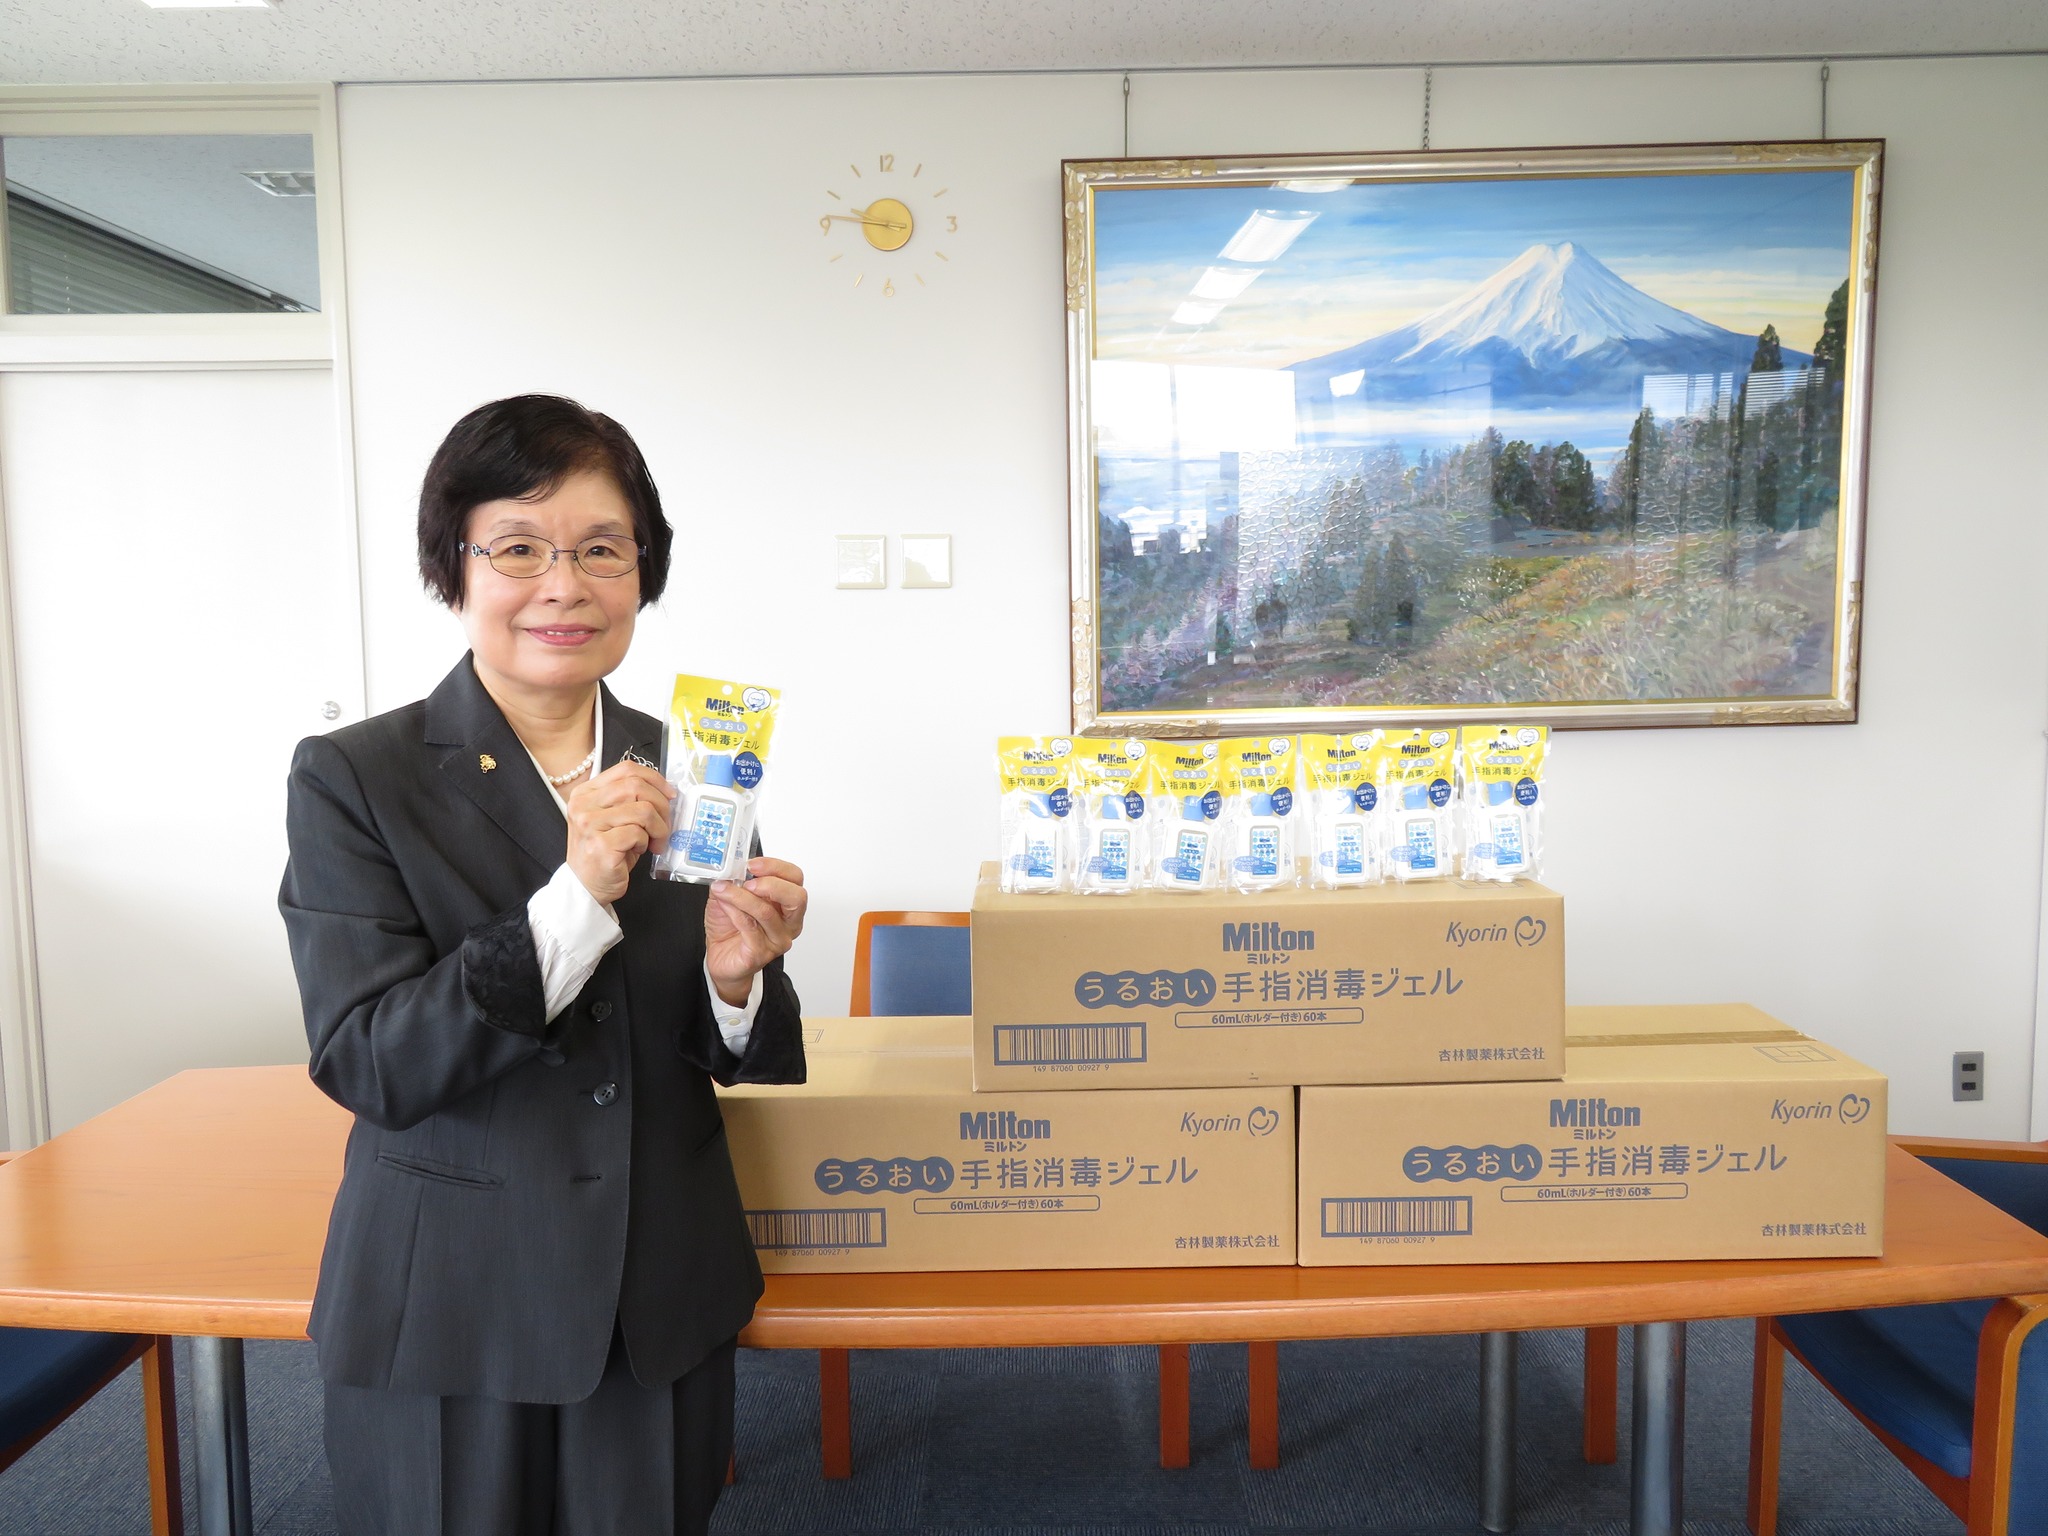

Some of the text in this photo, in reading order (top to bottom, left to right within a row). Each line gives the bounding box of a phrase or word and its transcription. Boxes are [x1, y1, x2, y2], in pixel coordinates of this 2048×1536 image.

[880, 154, 894, 172] 12
[819, 214, 832, 236] 9
[946, 215, 958, 233] 3
[882, 277, 895, 297] 6
[1242, 752, 1272, 762] Milton
[1401, 745, 1431, 754] Milton
[1175, 756, 1204, 767] Milton
[1222, 922, 1315, 952] Milton
[1445, 921, 1508, 947] Kyorin
[1247, 953, 1290, 964] ミルトン
[1084, 967, 1464, 1003] うるおい 手指消毒ジェル
[1438, 1047, 1545, 1061] 杏林製薬株式会社
[1104, 1063, 1110, 1071] 9
[1550, 1098, 1641, 1128] Milton
[1771, 1099, 1832, 1125] Kyorin
[960, 1111, 1051, 1140] Milton
[1180, 1111, 1241, 1137] Kyorin
[1573, 1129, 1616, 1140] ミルトン
[984, 1141, 1027, 1152] ミルトン
[1411, 1144, 1788, 1178] うるおい 手指消毒ジェル
[824, 1156, 1198, 1190] うるおい 手指消毒ジェル
[1762, 1222, 1867, 1237] 杏林製薬株式会社
[1175, 1234, 1280, 1249] 杏林製薬株式会社
